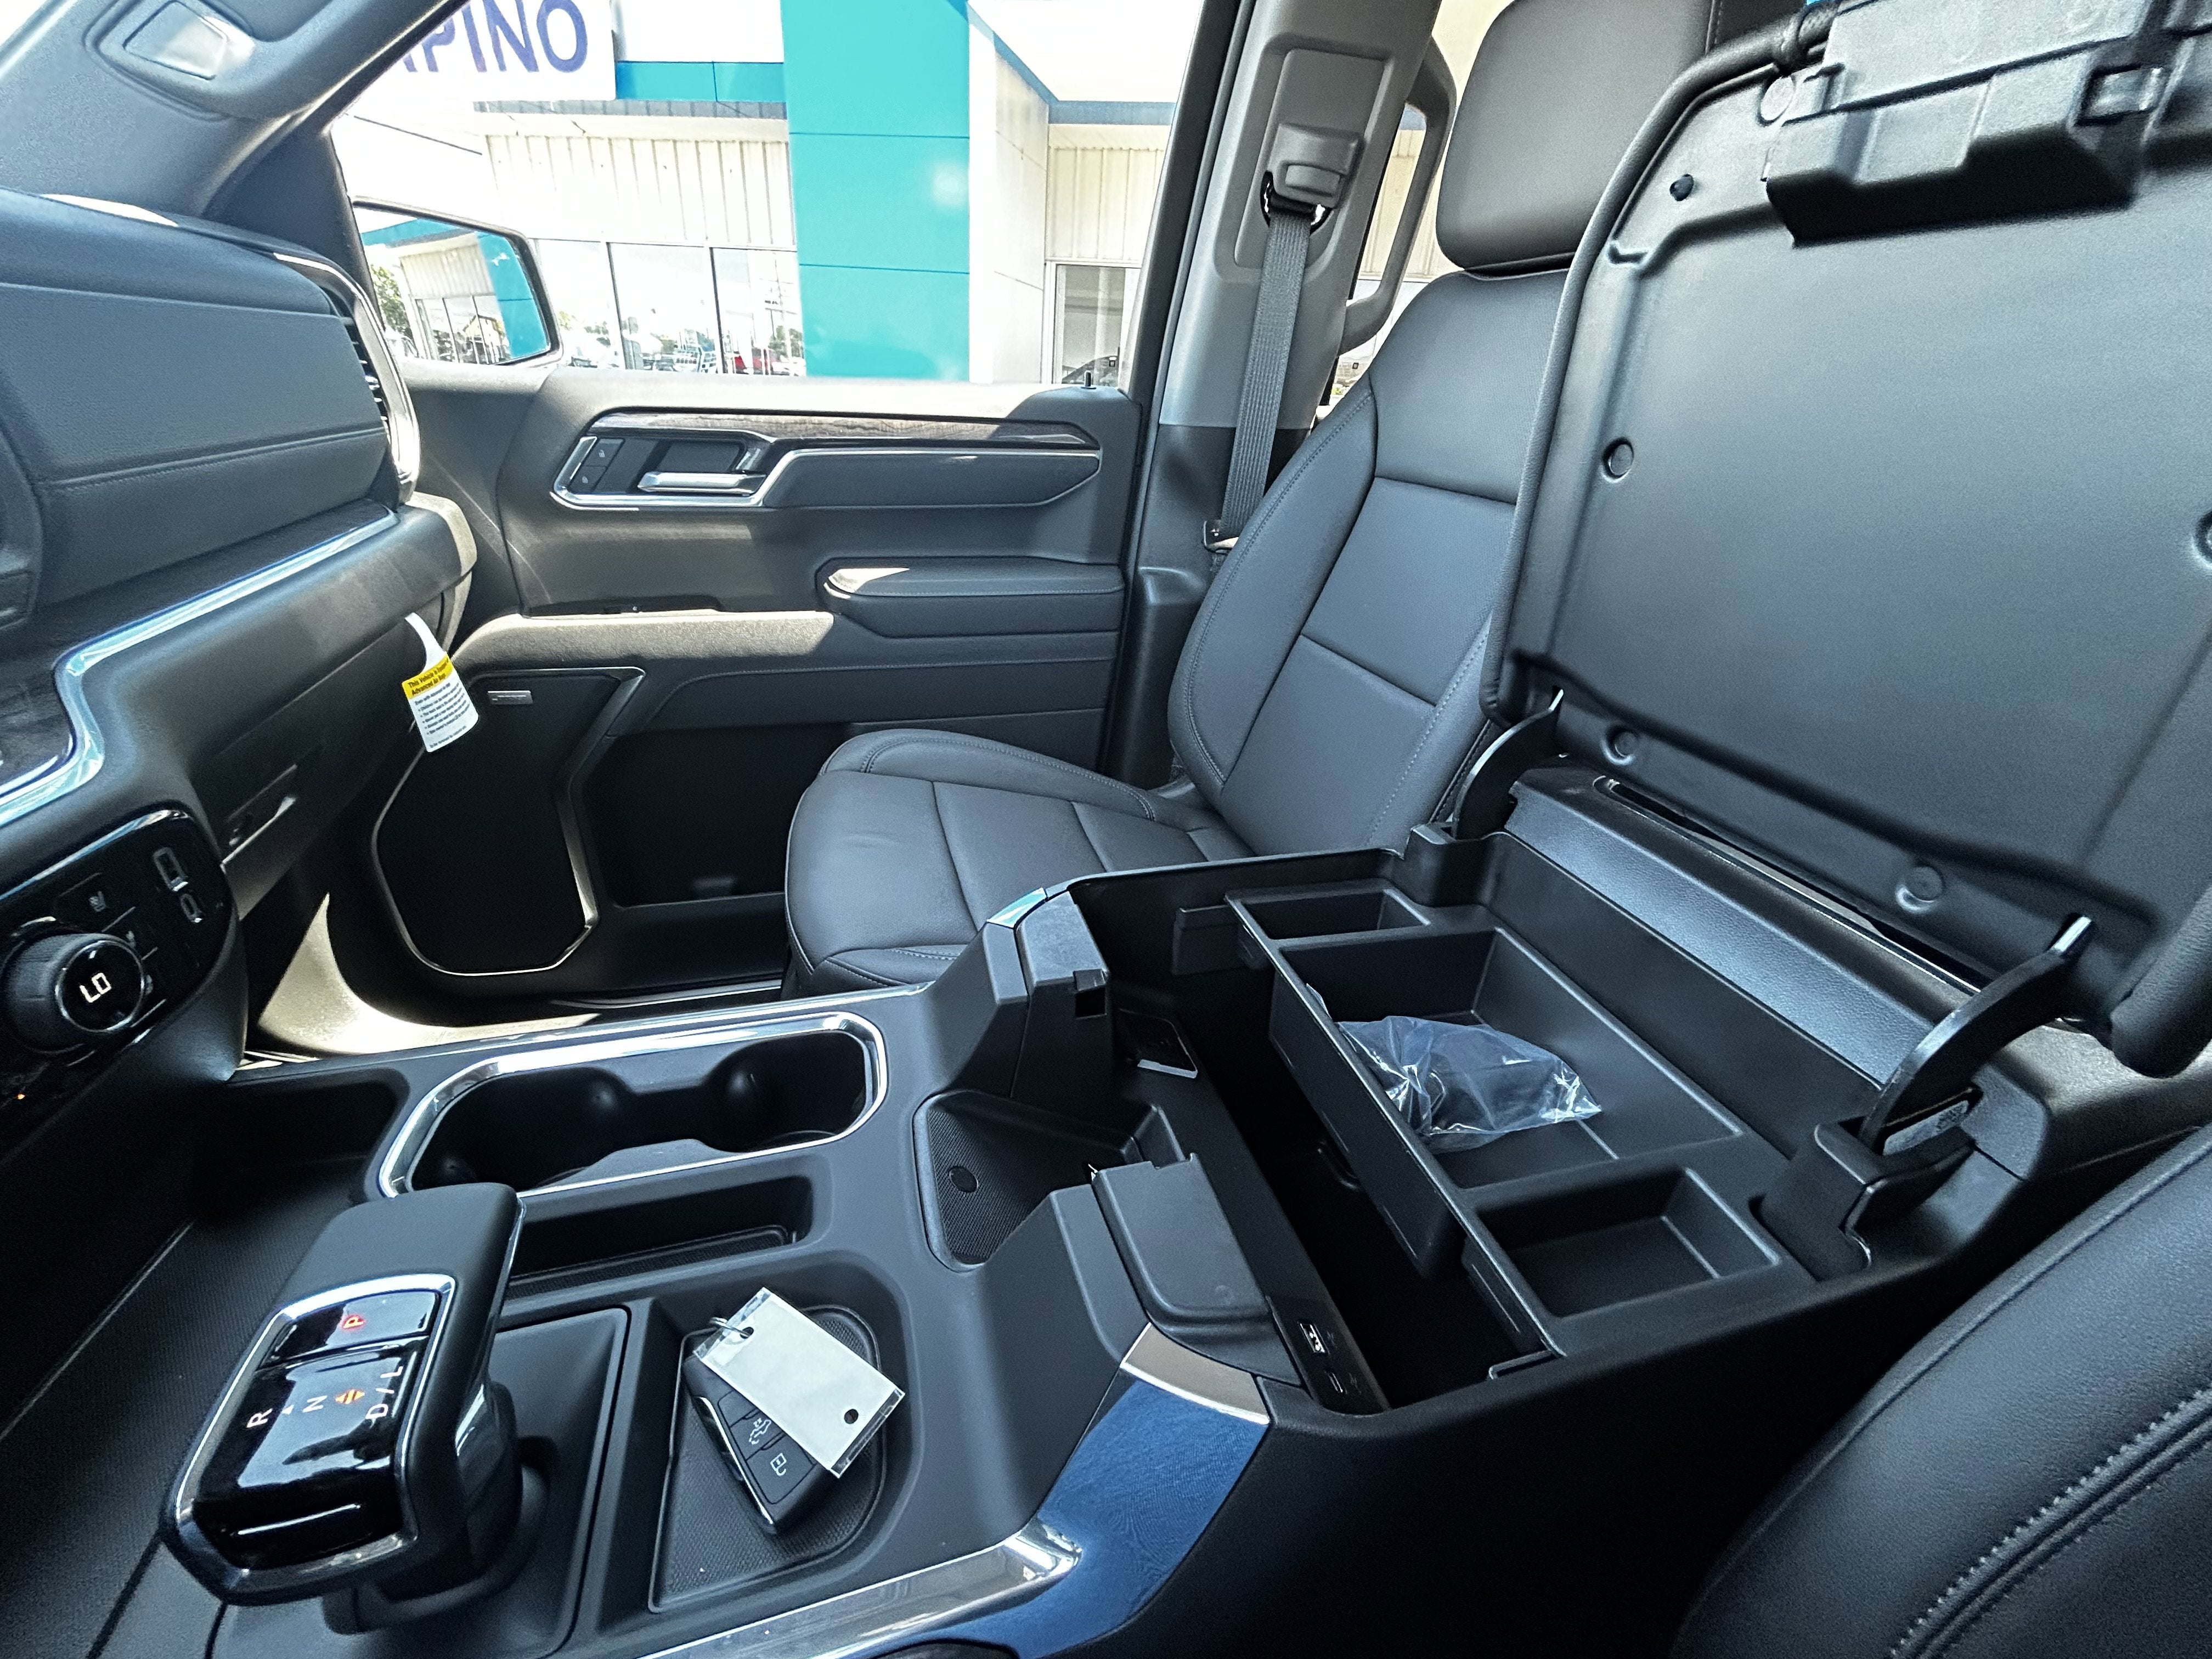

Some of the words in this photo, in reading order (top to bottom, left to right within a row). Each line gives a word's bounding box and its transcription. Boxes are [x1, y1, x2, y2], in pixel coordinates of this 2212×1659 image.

[403, 0, 588, 72] PINO
[343, 1316, 364, 1328] P
[246, 1408, 273, 1428] R
